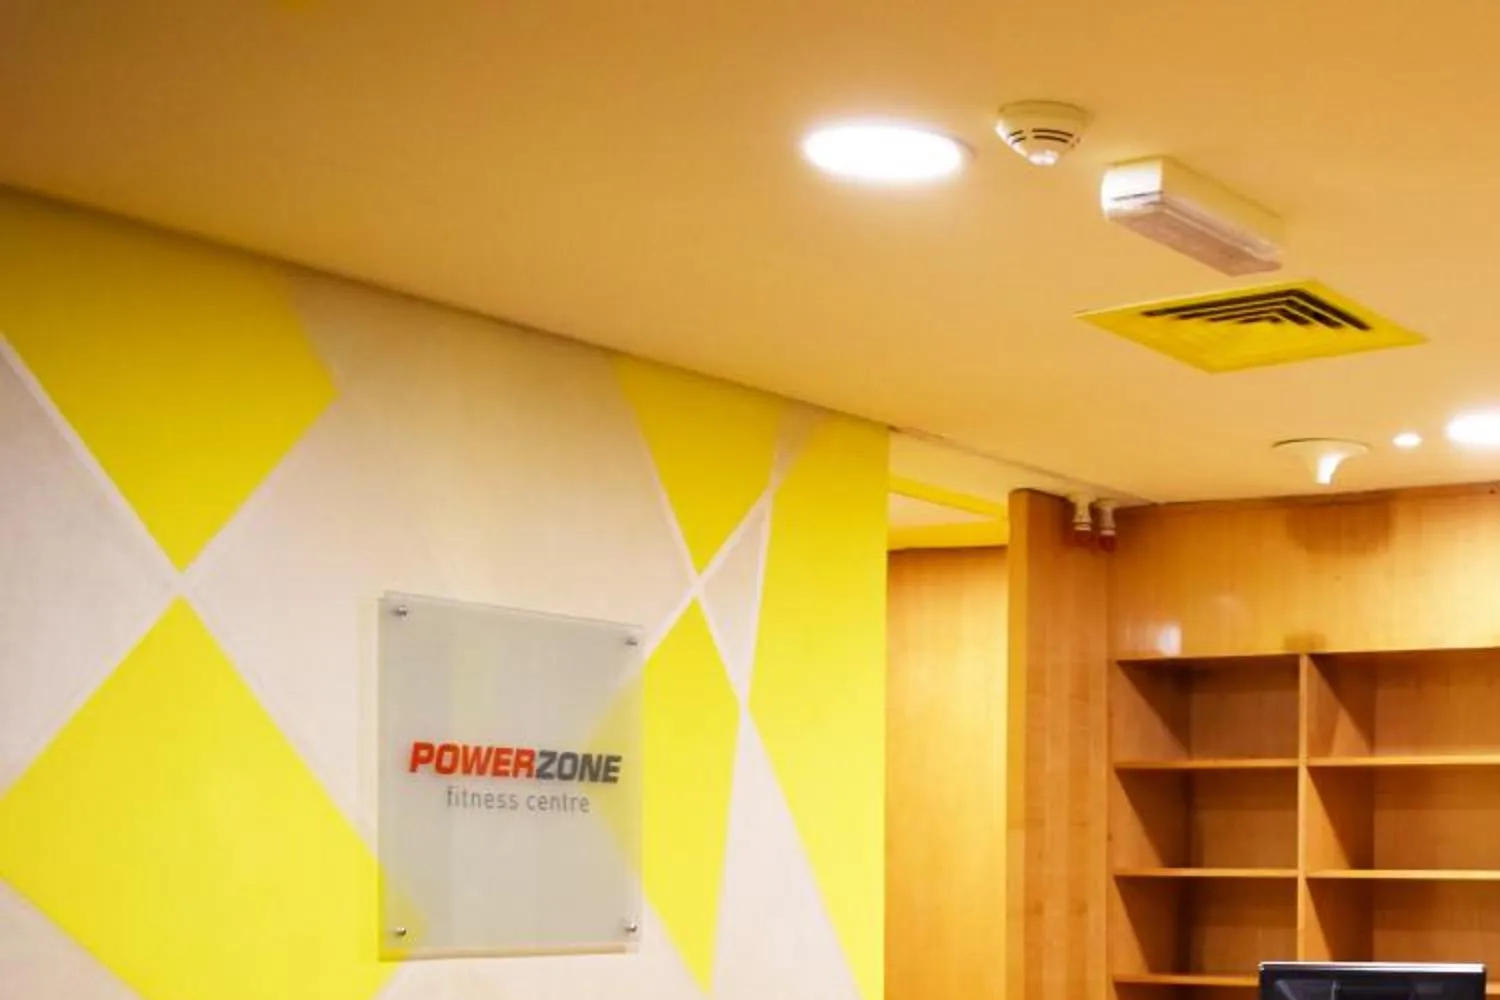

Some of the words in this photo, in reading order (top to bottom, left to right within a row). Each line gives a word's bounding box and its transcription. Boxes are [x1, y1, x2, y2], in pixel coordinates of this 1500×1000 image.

[409, 741, 623, 784] POWERZONE
[446, 785, 520, 810] fitness
[526, 792, 591, 813] centre
